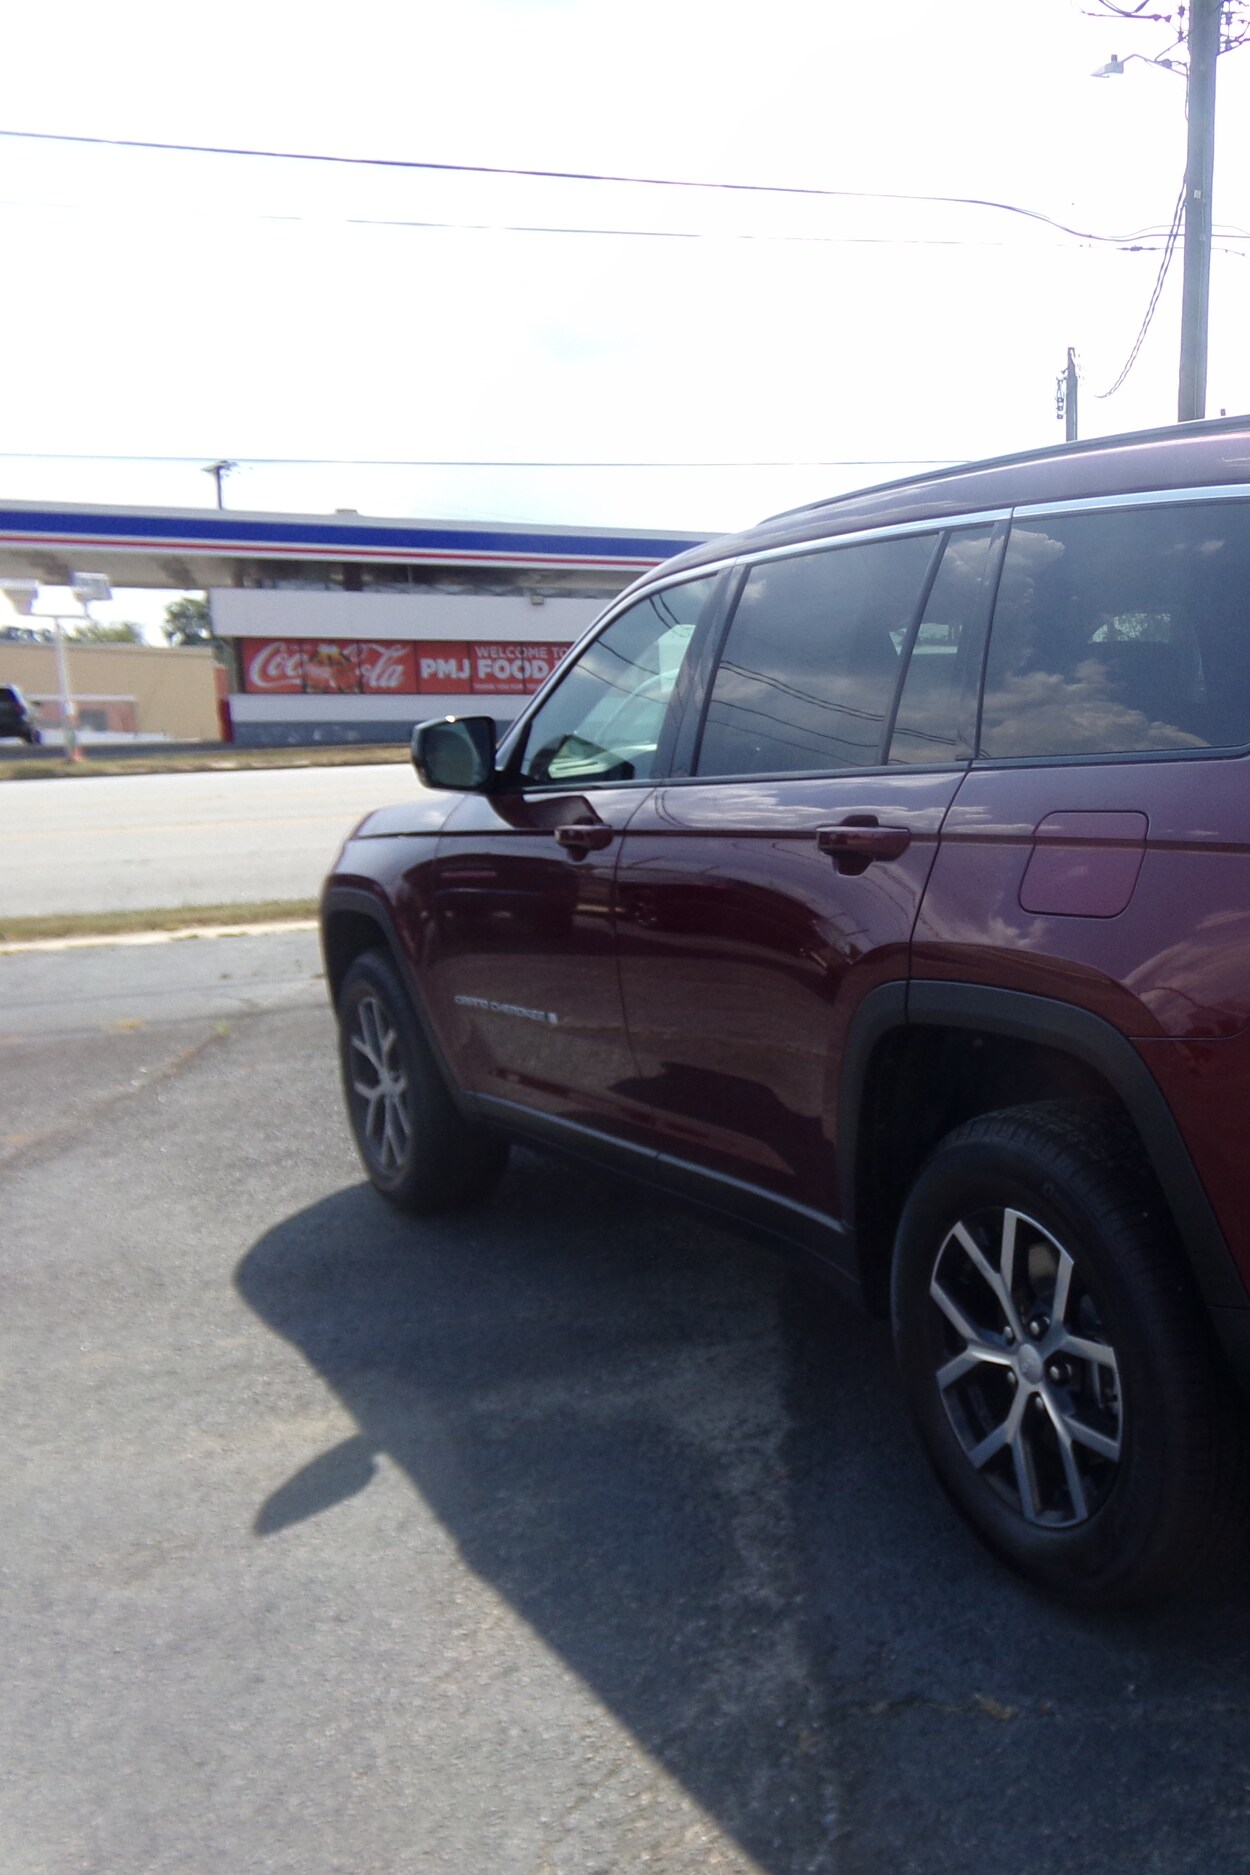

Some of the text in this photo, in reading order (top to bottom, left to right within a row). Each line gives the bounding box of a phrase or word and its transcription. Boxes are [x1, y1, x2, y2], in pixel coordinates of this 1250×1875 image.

[475, 646, 548, 658] WELCOME
[420, 658, 470, 679] PMJ
[477, 658, 549, 680] FOOD
